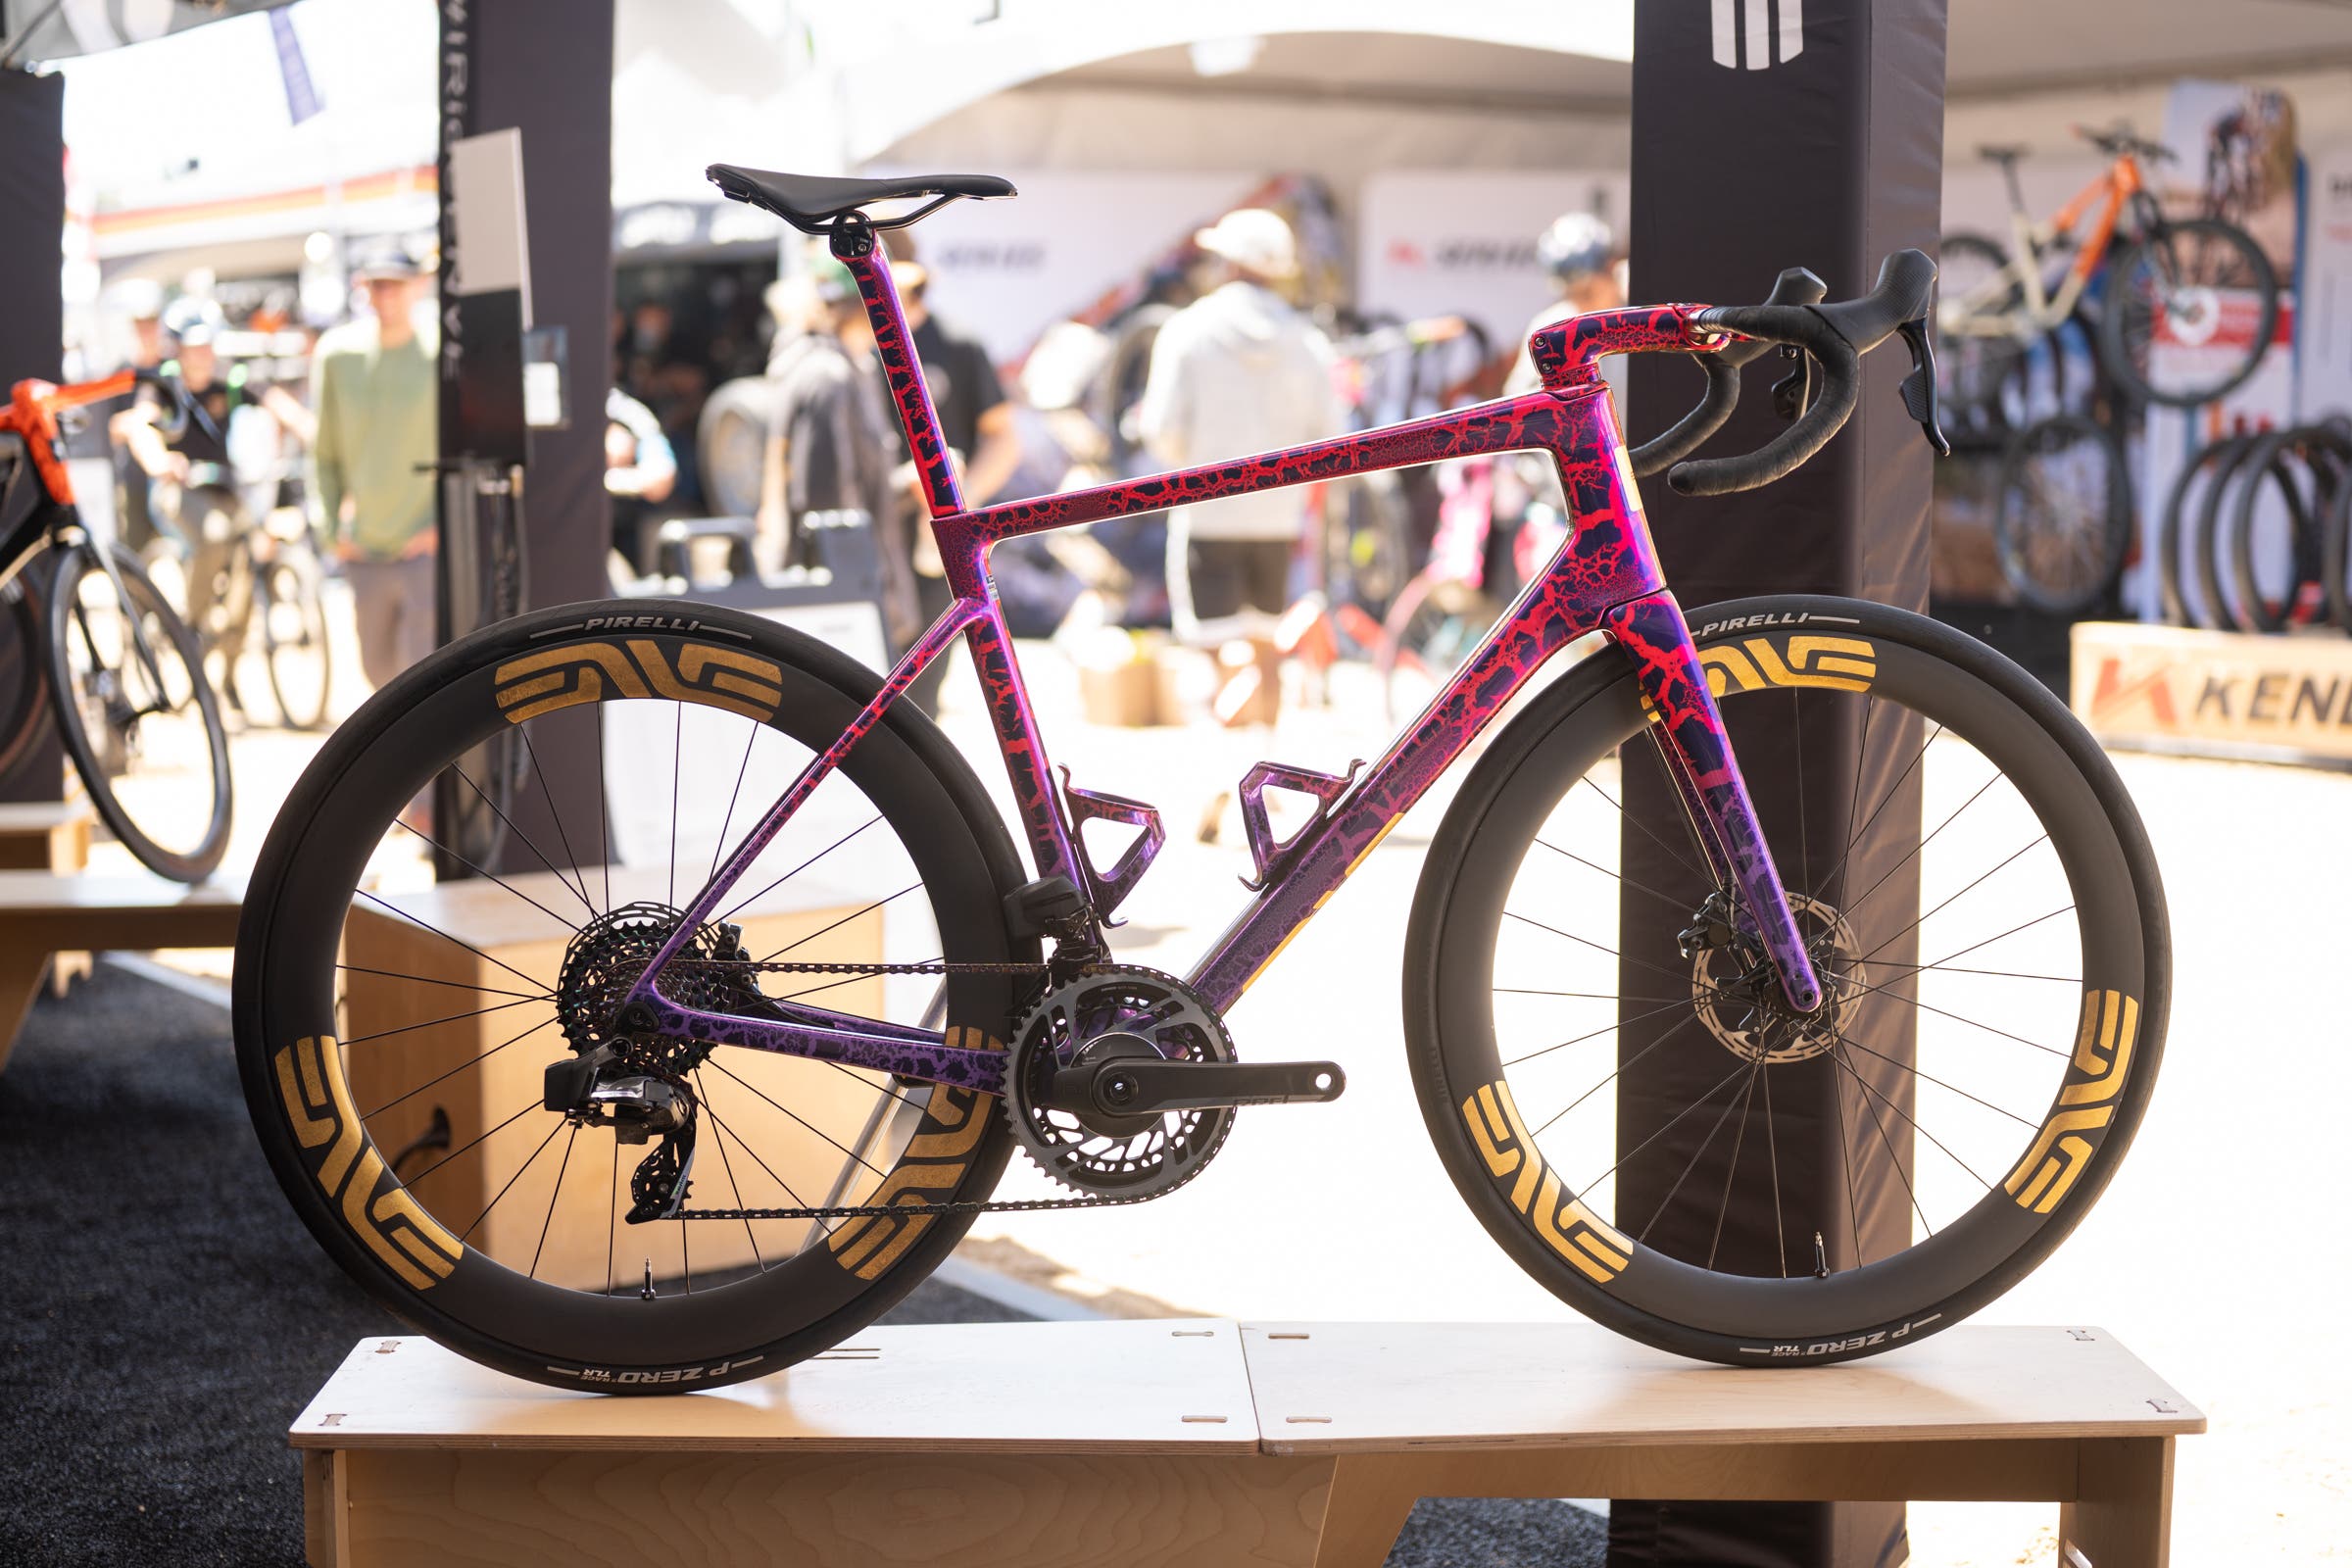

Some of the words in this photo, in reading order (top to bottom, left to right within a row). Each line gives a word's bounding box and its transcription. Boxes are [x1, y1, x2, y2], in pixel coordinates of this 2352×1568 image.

[584, 615, 700, 631] PIRELLI
[1701, 612, 1810, 637] PIRELLI
[1891, 1322, 1911, 1339] P
[1806, 1331, 1887, 1355] ZERO
[583, 1368, 611, 1378] TLR
[617, 1366, 704, 1384] ZERO
[709, 1361, 730, 1377] P
